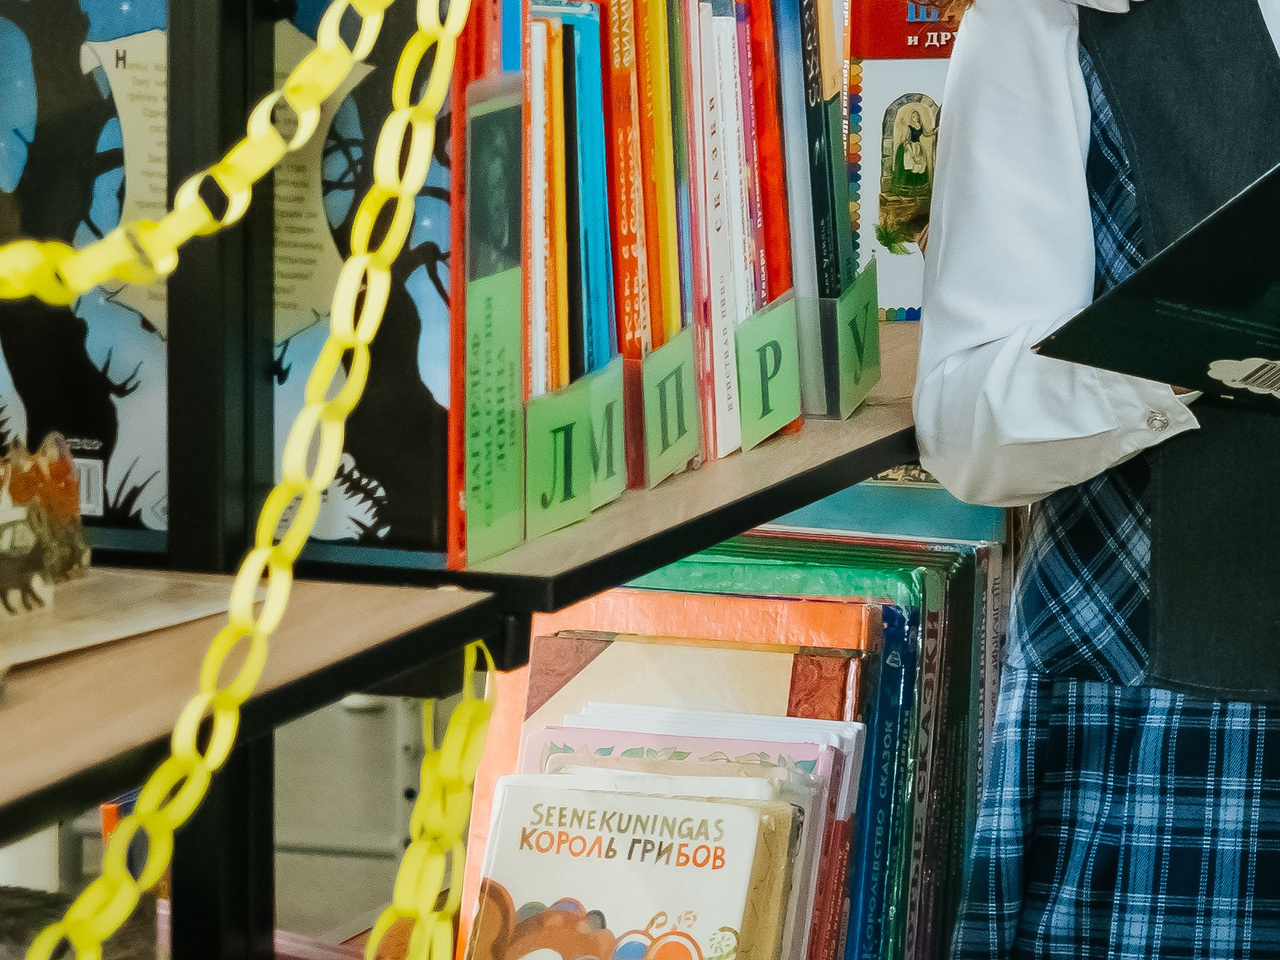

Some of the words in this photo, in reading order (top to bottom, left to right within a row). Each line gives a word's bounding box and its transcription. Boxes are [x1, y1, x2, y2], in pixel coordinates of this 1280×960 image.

[907, 35, 918, 46] и
[842, 59, 850, 116] Красная
[708, 97, 723, 233] СКАЗКИ
[655, 366, 689, 456] П
[756, 340, 783, 420] Р
[541, 422, 577, 510] Л
[916, 608, 939, 804] СКАЗКИ
[519, 826, 618, 859] КОРОЛЬ
[627, 838, 727, 871] ГРИБОВ
[530, 803, 725, 842] SEENEKUNINGAS
[861, 808, 885, 960] КОРОЛЕВСТВО
[878, 719, 894, 799] СКАЗОК
